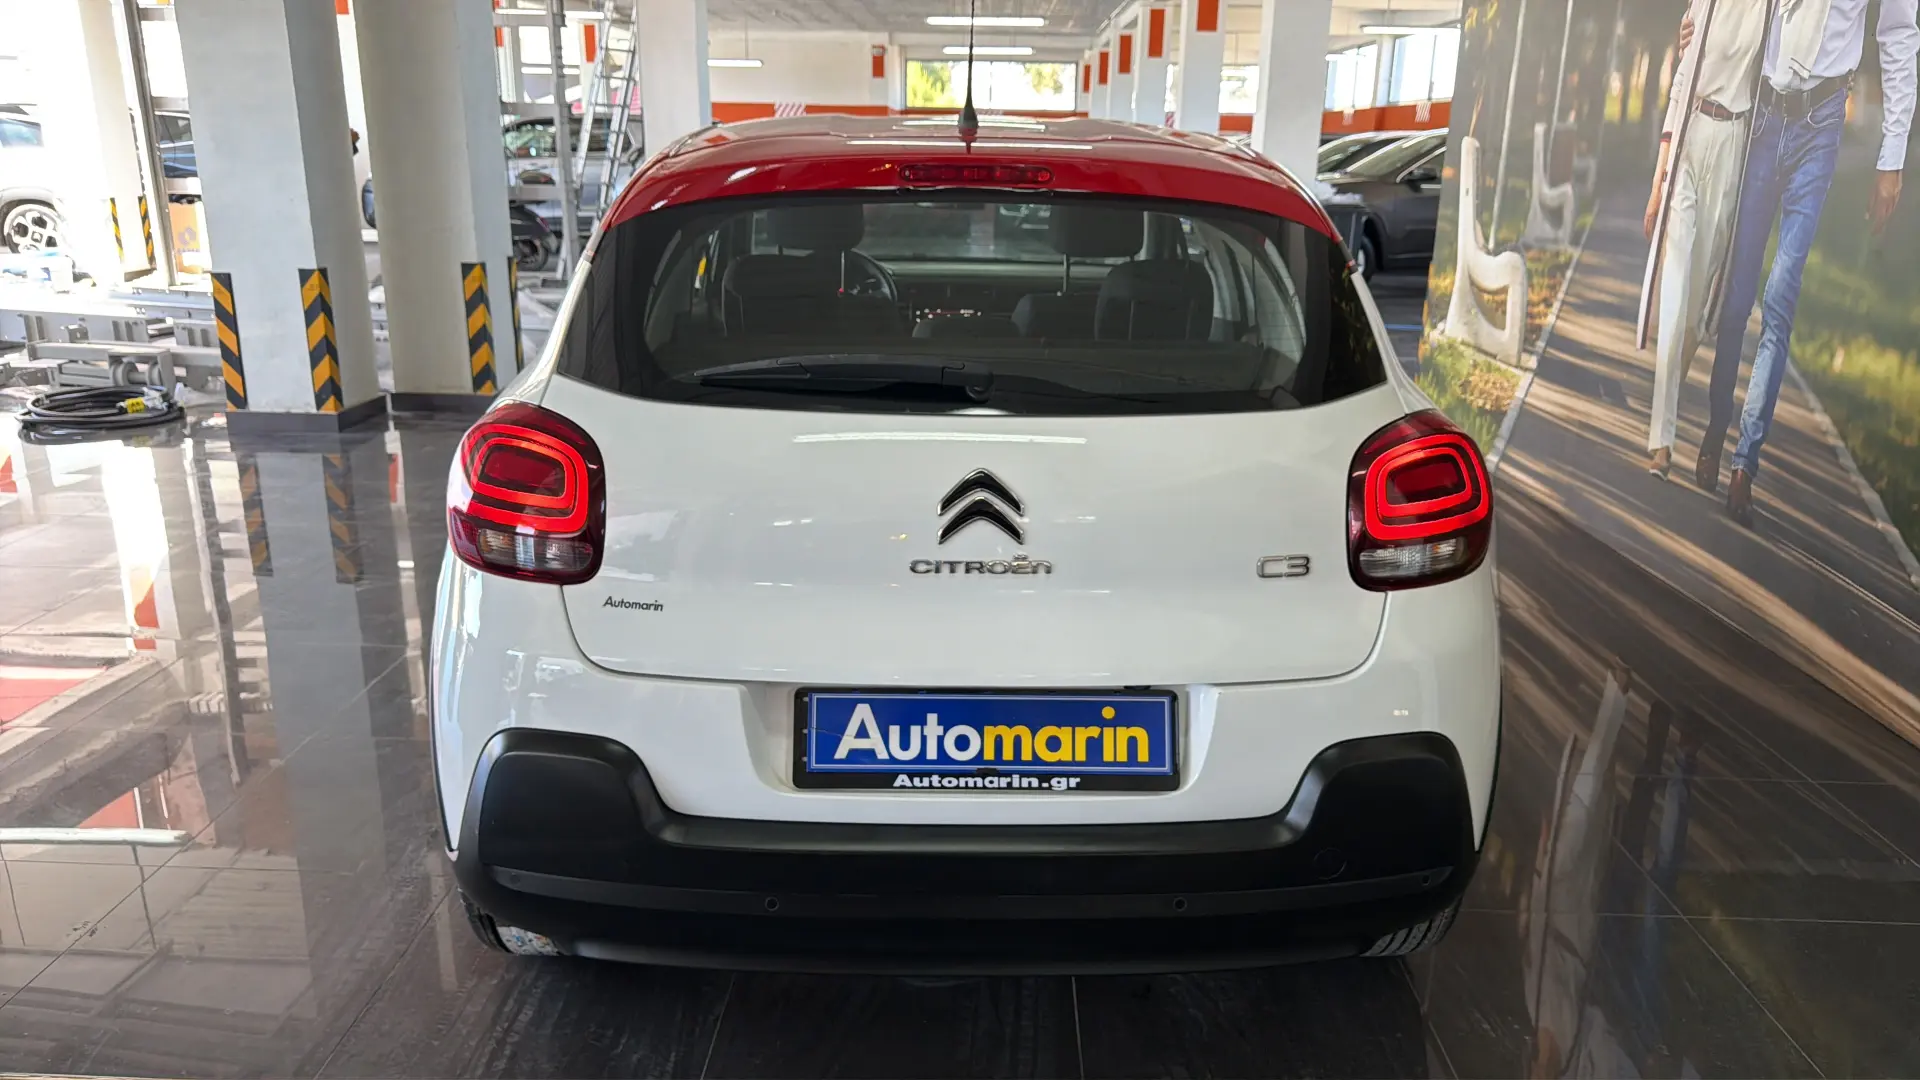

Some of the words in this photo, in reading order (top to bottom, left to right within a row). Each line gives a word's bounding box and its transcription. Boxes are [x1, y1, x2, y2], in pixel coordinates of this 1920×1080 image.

[1256, 554, 1310, 578] C3
[602, 595, 664, 612] Automarin
[833, 703, 1149, 763] Automarin
[892, 773, 1081, 791] Automarin.gr
